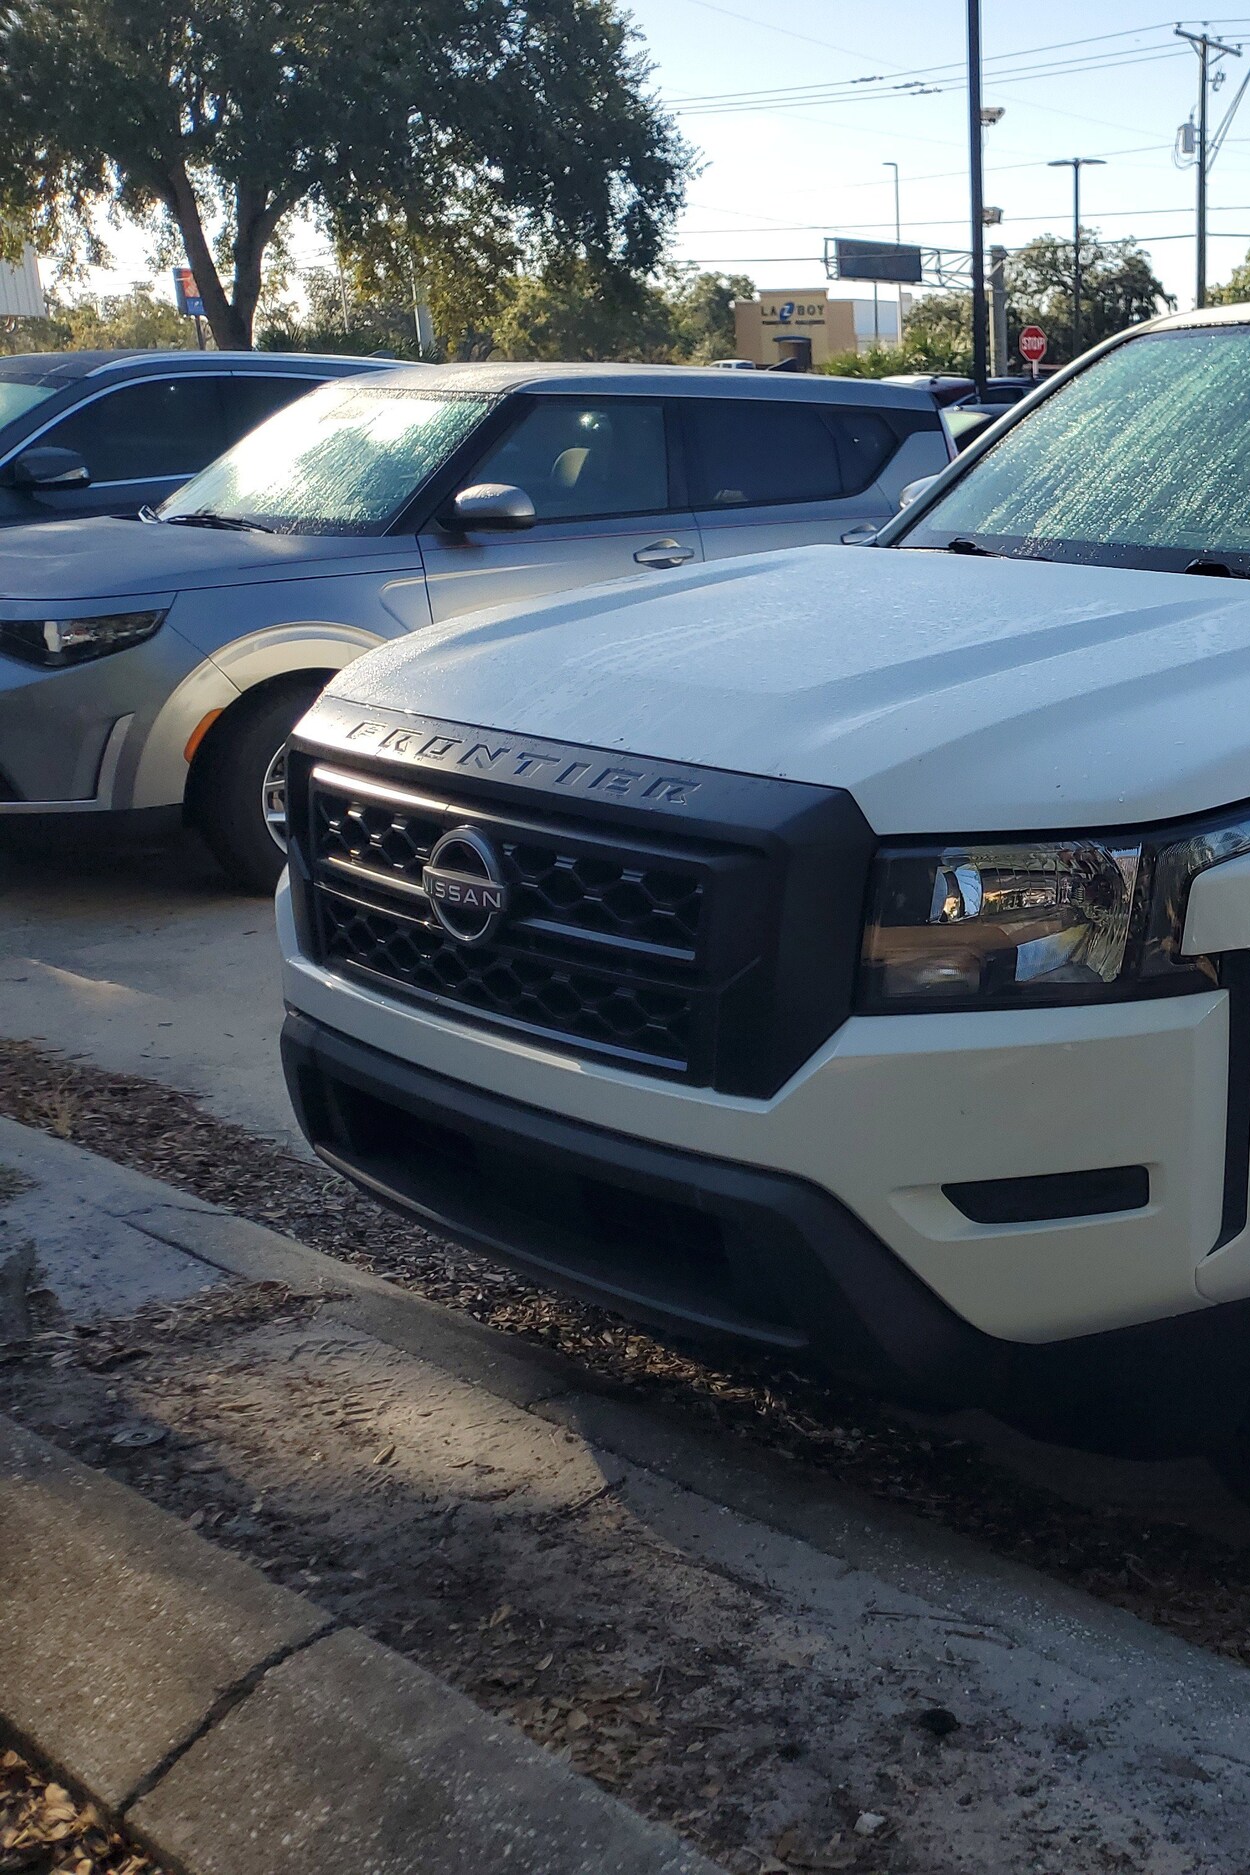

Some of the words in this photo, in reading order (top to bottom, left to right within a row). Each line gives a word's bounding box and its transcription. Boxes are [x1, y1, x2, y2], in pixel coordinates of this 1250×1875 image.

[796, 304, 825, 316] BOY
[1021, 336, 1045, 350] STOP
[346, 720, 702, 806] FRONTIER
[423, 874, 501, 908] NISSAN
